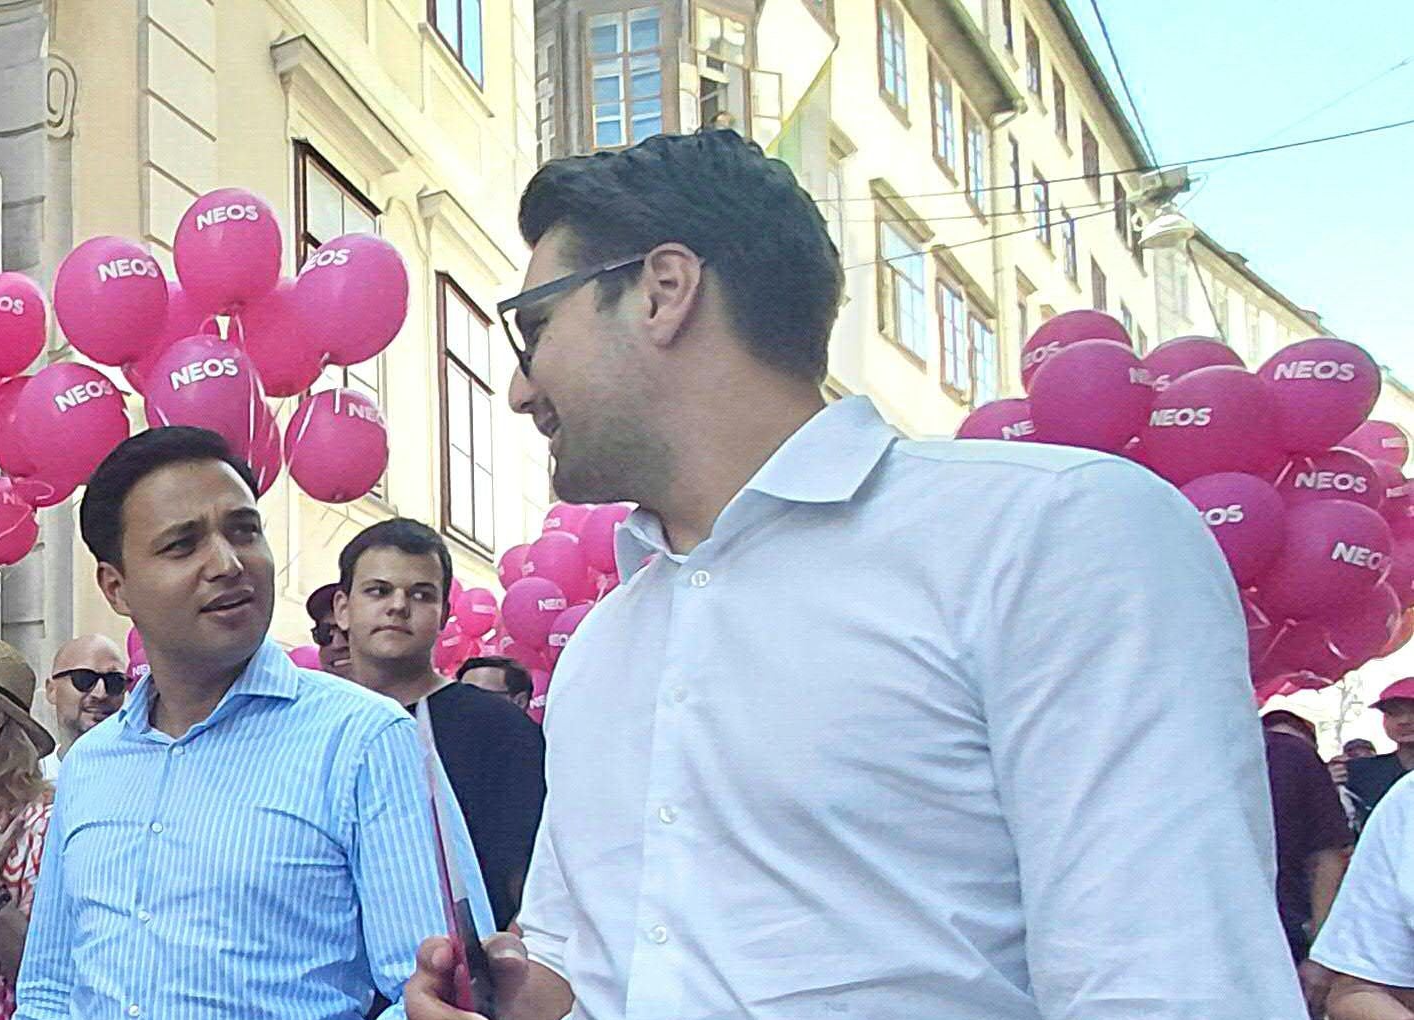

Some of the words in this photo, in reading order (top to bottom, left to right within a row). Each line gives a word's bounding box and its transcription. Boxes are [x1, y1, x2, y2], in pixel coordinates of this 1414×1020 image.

[195, 203, 260, 231] NEOS
[97, 257, 159, 283] NEOS
[170, 356, 239, 391] NEOS
[1273, 359, 1355, 382] NEOS
[53, 379, 114, 413] NEOS
[1294, 471, 1368, 494] NEOS
[1199, 504, 1244, 526] OS
